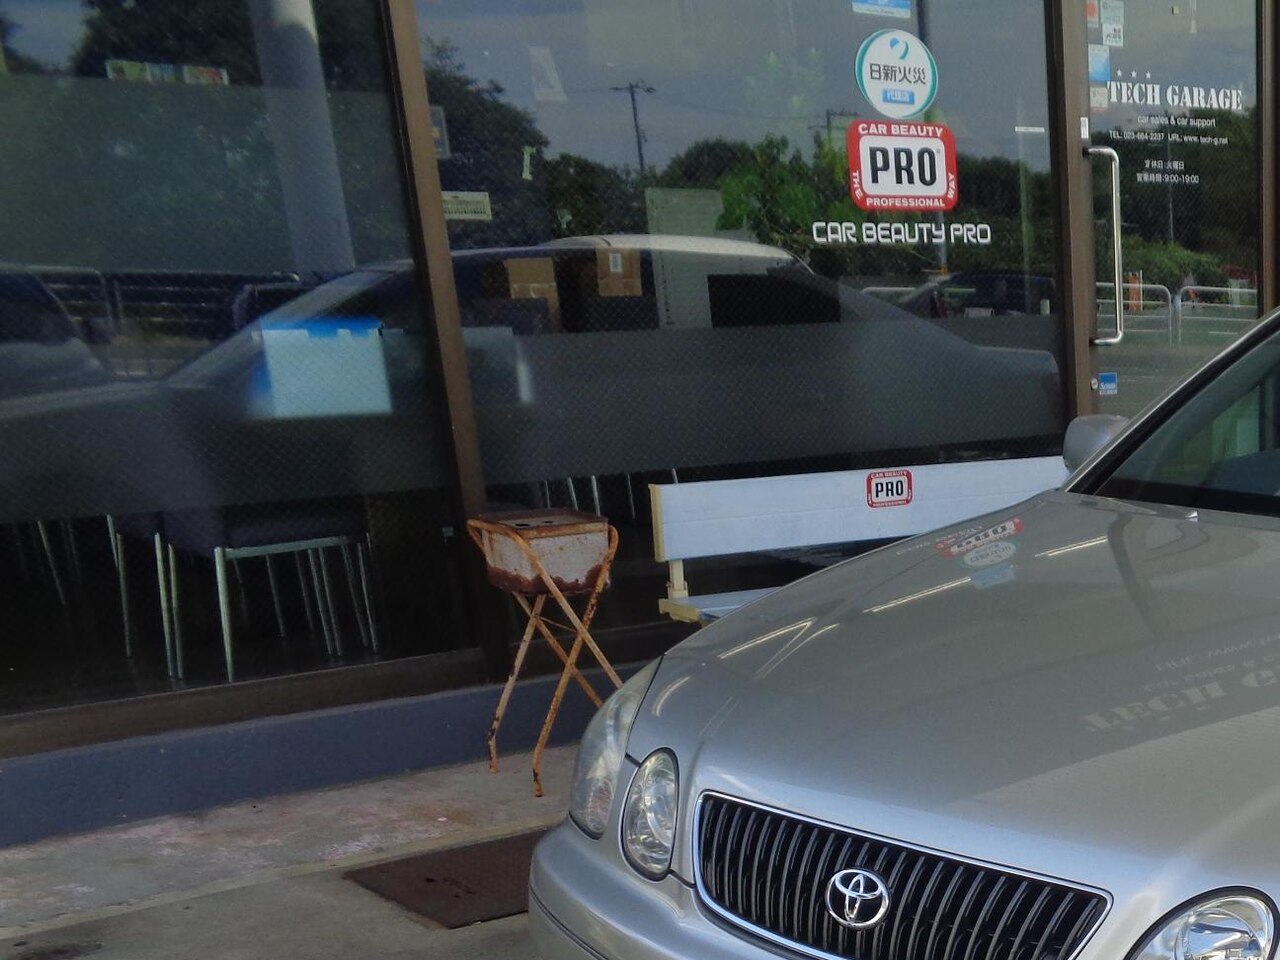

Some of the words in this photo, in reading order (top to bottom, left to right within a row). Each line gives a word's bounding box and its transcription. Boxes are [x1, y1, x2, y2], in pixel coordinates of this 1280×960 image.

[869, 63, 926, 85] 日新火災
[1107, 80, 1161, 105] TECH
[1166, 85, 1243, 110] GARAGE
[858, 123, 888, 135] CAR
[891, 124, 944, 137] BEAUTY
[1137, 115, 1149, 123] car
[1150, 116, 1169, 125] sales
[1170, 117, 1175, 125] &
[1189, 118, 1216, 128] support
[869, 147, 937, 186] PRO
[852, 170, 862, 199] THE
[947, 172, 956, 200] WAY
[866, 197, 945, 208] PROFESSIONAL
[812, 221, 857, 243] CAR
[862, 222, 945, 244] BEAUTY
[950, 223, 991, 245] PRO
[875, 480, 904, 498] PRO
